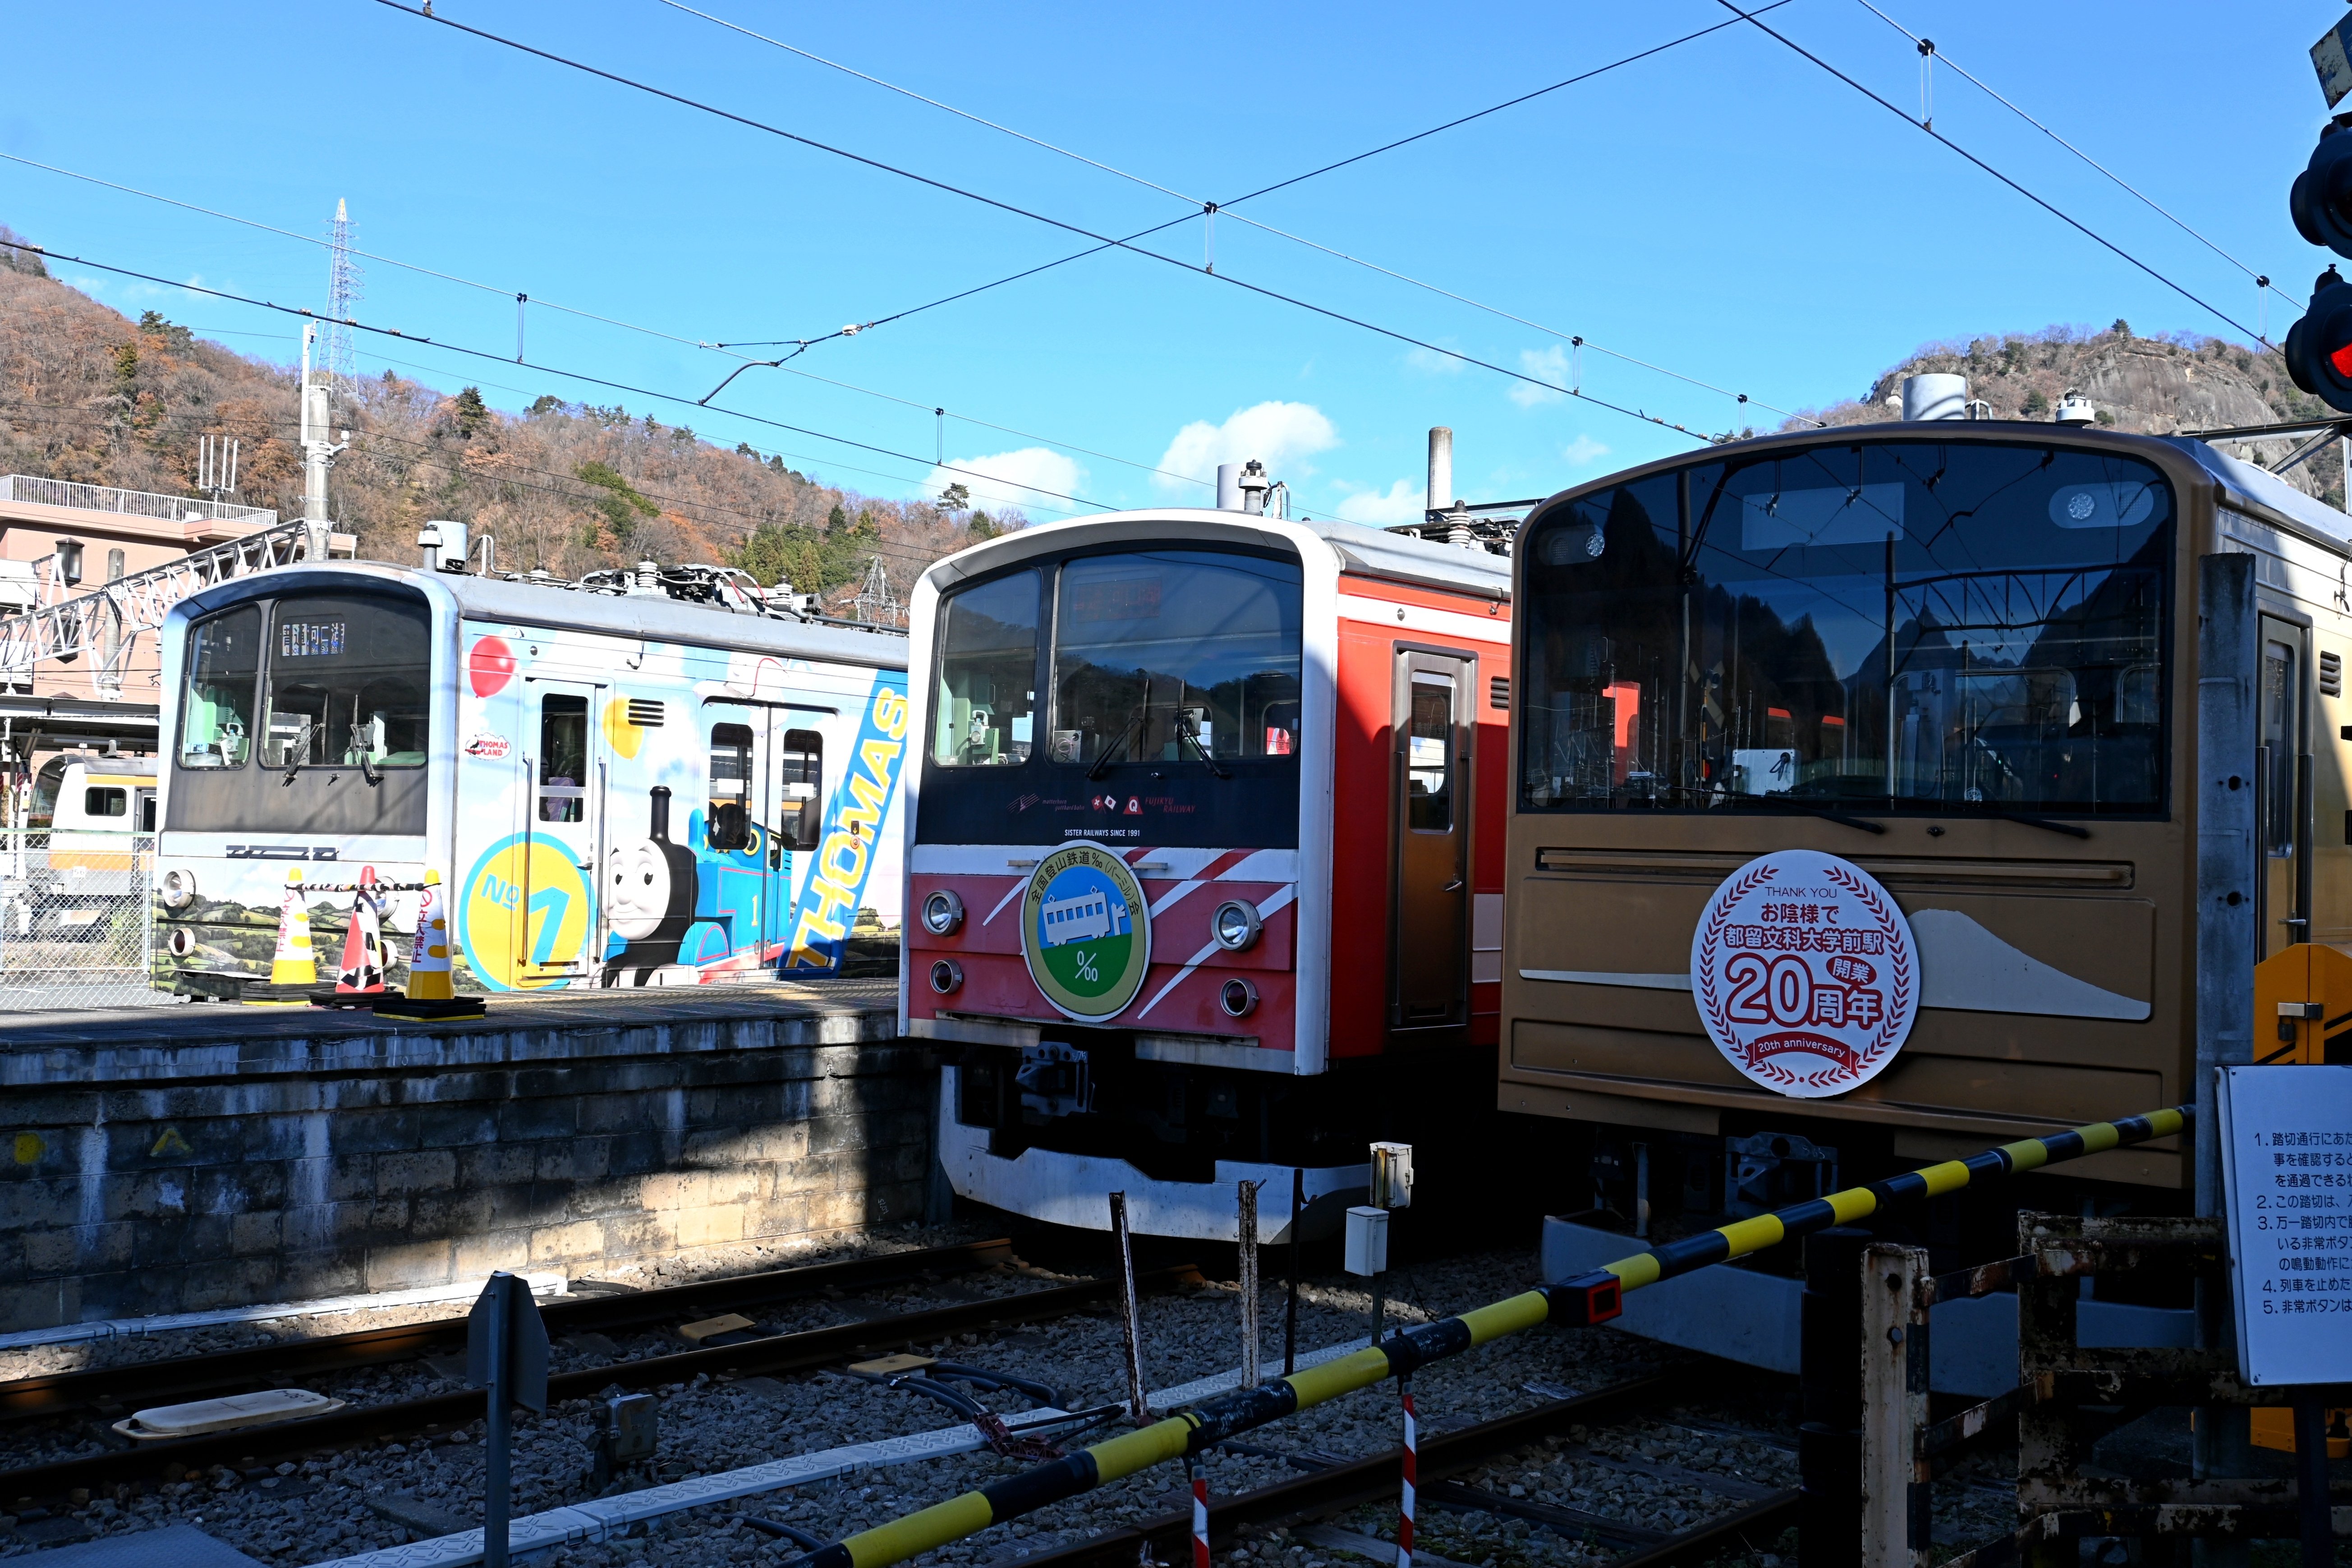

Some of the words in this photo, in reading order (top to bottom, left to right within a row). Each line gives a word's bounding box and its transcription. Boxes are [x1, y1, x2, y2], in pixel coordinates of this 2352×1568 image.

[479, 740, 508, 749] THOMAS
[1129, 799, 1137, 812] Q
[1145, 797, 1174, 807] FUJIKYU
[1163, 805, 1196, 813] RAILWAY
[786, 686, 907, 970] THOMAS
[1764, 887, 1806, 897] THANK
[1810, 888, 1837, 898] YOU
[751, 894, 758, 927] 1
[1761, 902, 1839, 924] お陰様で
[276, 904, 290, 952] 立入禁止
[412, 909, 428, 963] 立入禁止
[528, 886, 570, 966] 1
[1725, 925, 1883, 954] 都留文科大学前駅
[1832, 958, 1870, 984] 開業
[1758, 1040, 1781, 1053] 20th
[1784, 1038, 1846, 1058] anniversary
[2258, 1215, 2352, 1230] 3.万一踏切内で
[2278, 1236, 2352, 1250] いる非常ボタ
[2279, 1257, 2352, 1271] の鳴動動作に
